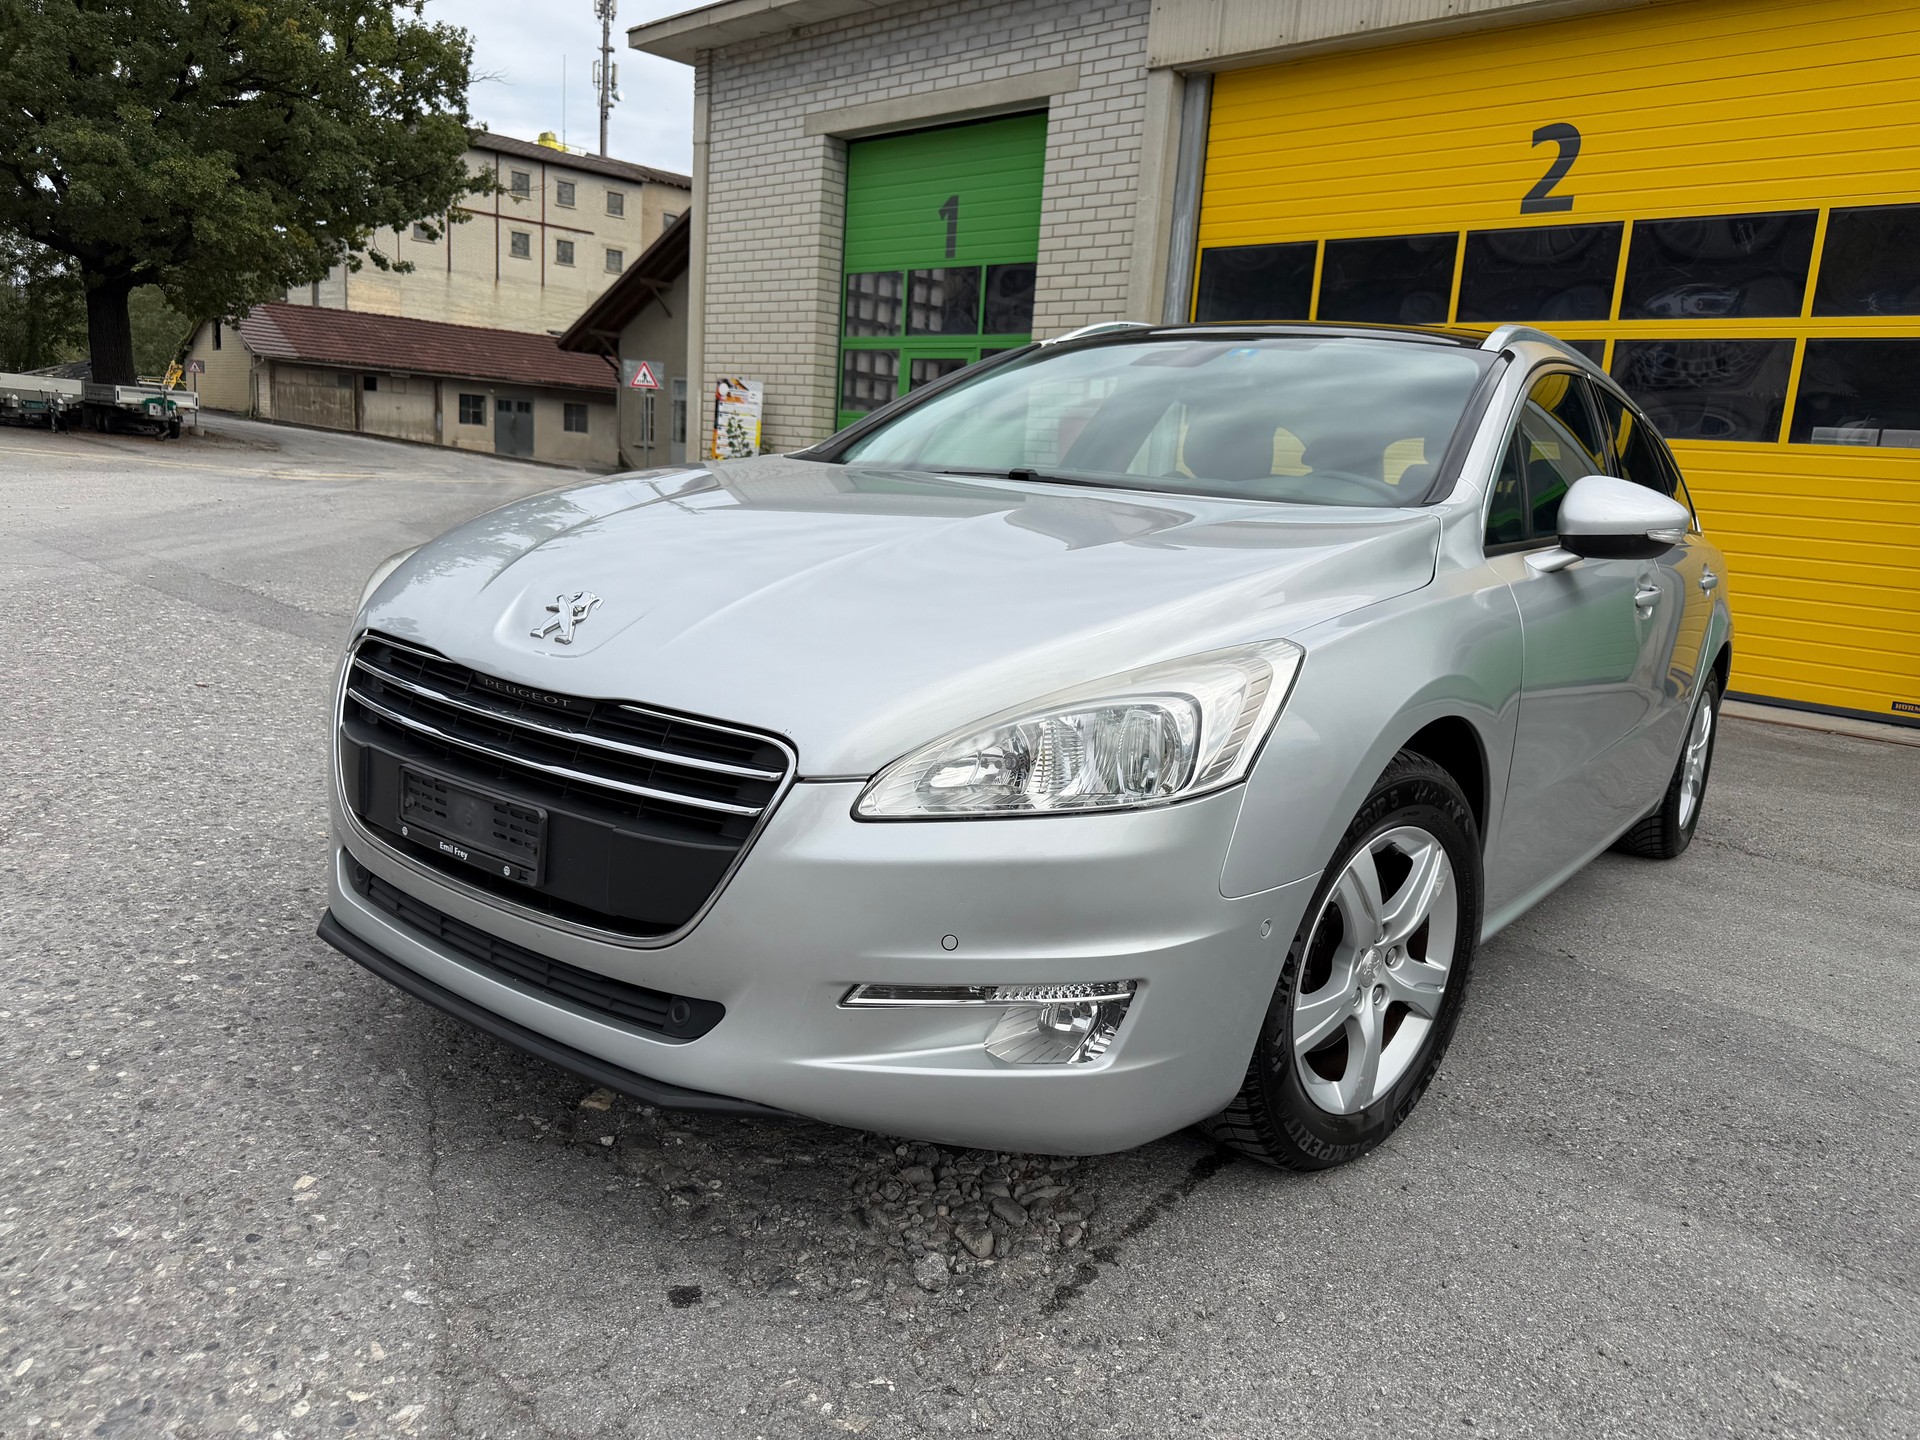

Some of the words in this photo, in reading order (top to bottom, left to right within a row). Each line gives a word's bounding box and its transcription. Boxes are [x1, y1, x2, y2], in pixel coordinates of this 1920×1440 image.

[1519, 122, 1582, 216] 2
[938, 194, 960, 259] 1
[485, 678, 572, 707] PEUGEOT
[440, 841, 454, 854] Emil
[454, 847, 469, 861] Frey
[1284, 1116, 1373, 1161] SEMPERIT
